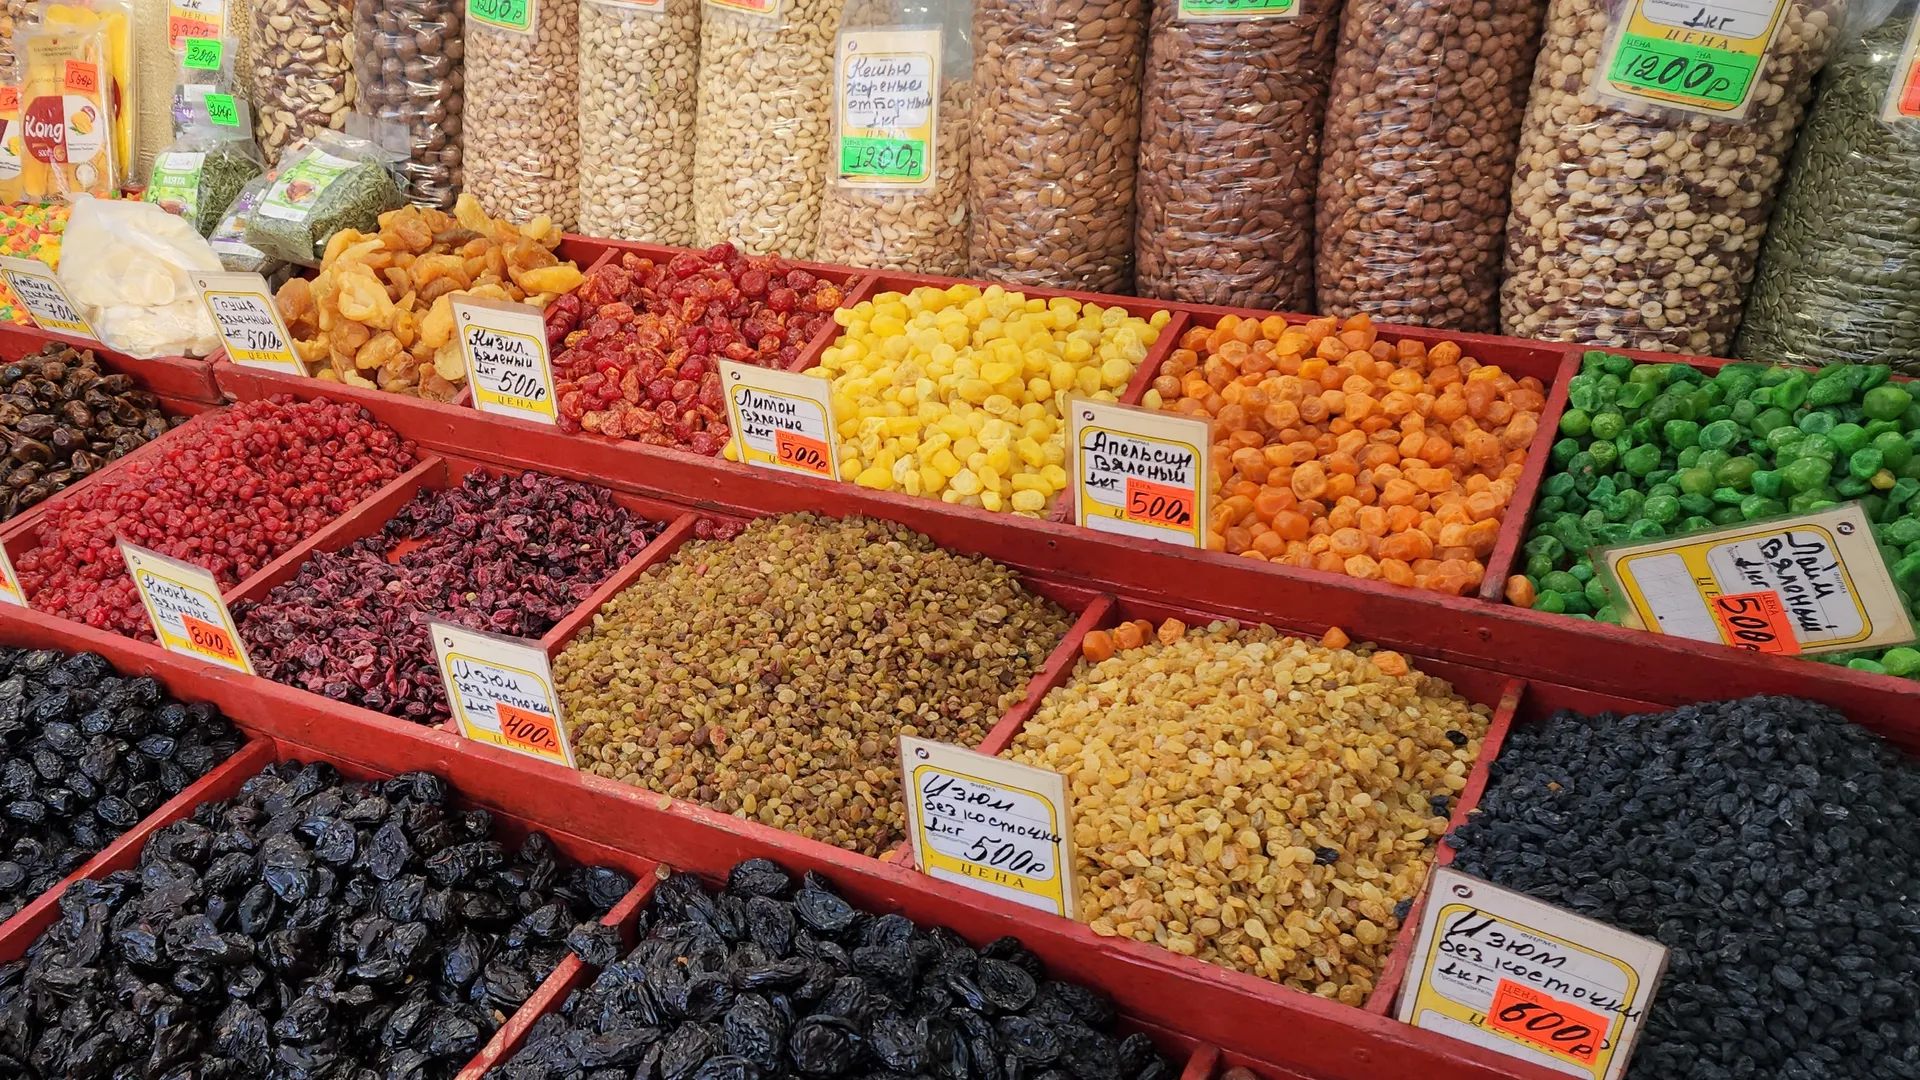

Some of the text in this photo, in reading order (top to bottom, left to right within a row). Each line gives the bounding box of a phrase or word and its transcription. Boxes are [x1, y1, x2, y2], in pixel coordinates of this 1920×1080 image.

[1683, 8, 1735, 30] 1кг
[1626, 39, 1651, 48] ЦЕНА
[1664, 29, 1729, 49] ЦЕНА
[1624, 54, 1730, 96] 1200р
[849, 144, 918, 176] 1200р
[247, 329, 283, 350] 500р
[248, 352, 279, 361] ЦЕНА
[476, 362, 546, 400] 1кг 500р
[498, 395, 534, 409] ЦЕНА
[734, 389, 796, 416] Лимон
[781, 442, 827, 469] 500р
[1081, 431, 1193, 469] Апельсин
[1130, 491, 1190, 525] 500р
[1785, 532, 1839, 600] Лайм
[1762, 593, 1779, 616] ЦЕНА
[456, 660, 522, 692] Изюм
[505, 715, 556, 748] 400р
[923, 774, 1014, 811] Изюм
[924, 793, 957, 816] без
[964, 809, 1062, 846] косточки
[924, 817, 965, 836] 1кг
[964, 836, 1046, 874] 500р
[961, 863, 1025, 889] ЦЕНА
[1438, 932, 1483, 962] без
[1450, 909, 1567, 969] Изюм
[1520, 932, 1558, 949] ФИРМА
[1503, 984, 1539, 1003] ЦЕНА
[1499, 1003, 1594, 1054] 600р
